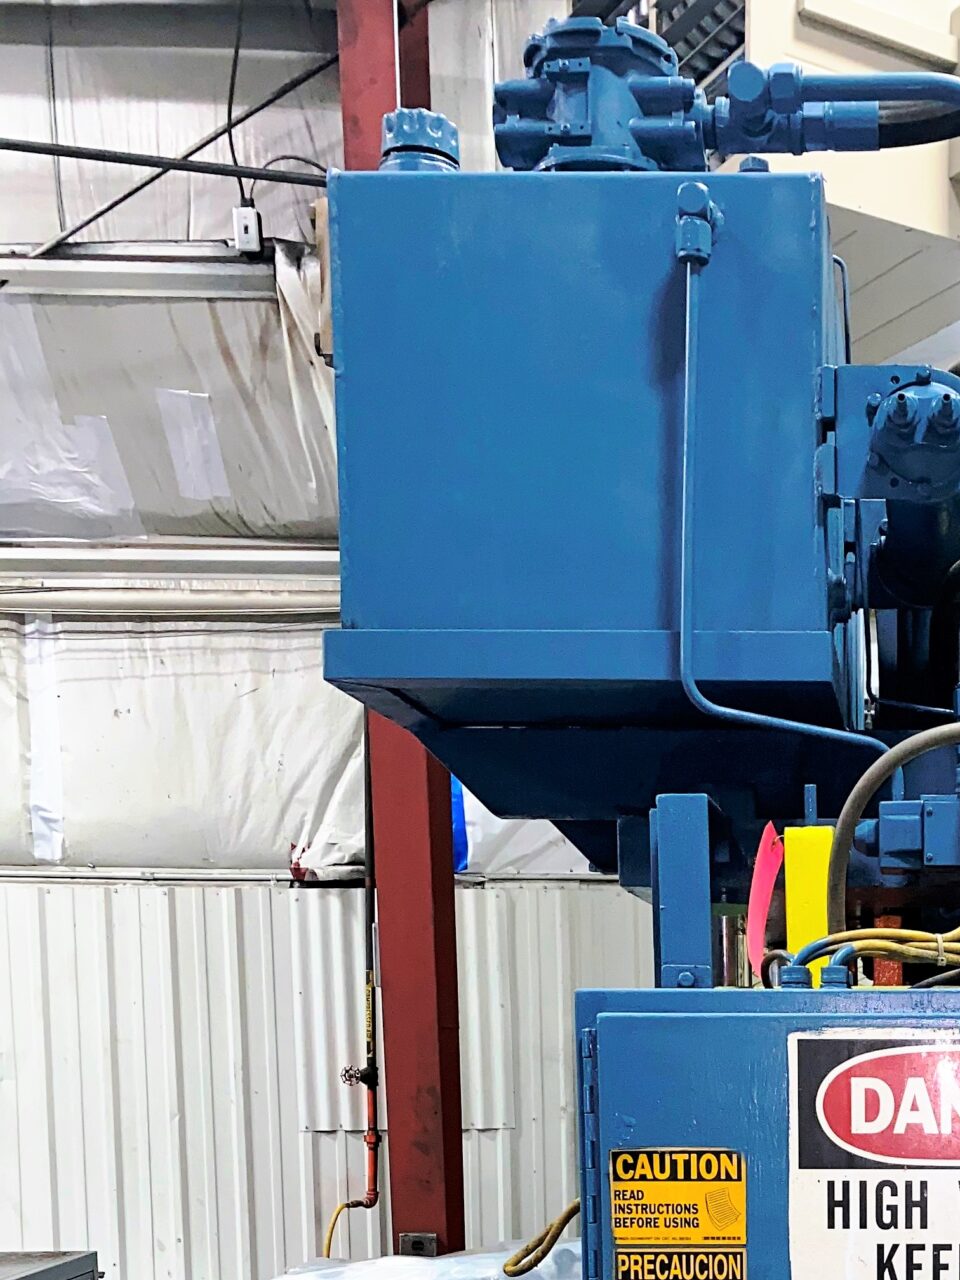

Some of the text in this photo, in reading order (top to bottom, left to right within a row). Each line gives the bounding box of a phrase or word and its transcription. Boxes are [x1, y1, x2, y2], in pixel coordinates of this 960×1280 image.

[615, 1153, 738, 1180] CAUTION
[614, 1189, 644, 1201] READ
[614, 1203, 699, 1215] INSTRUCTIONS
[826, 1180, 928, 1230] HIGH
[614, 1217, 700, 1228] BEFORE USING
[617, 1253, 741, 1280] PRECAUCION
